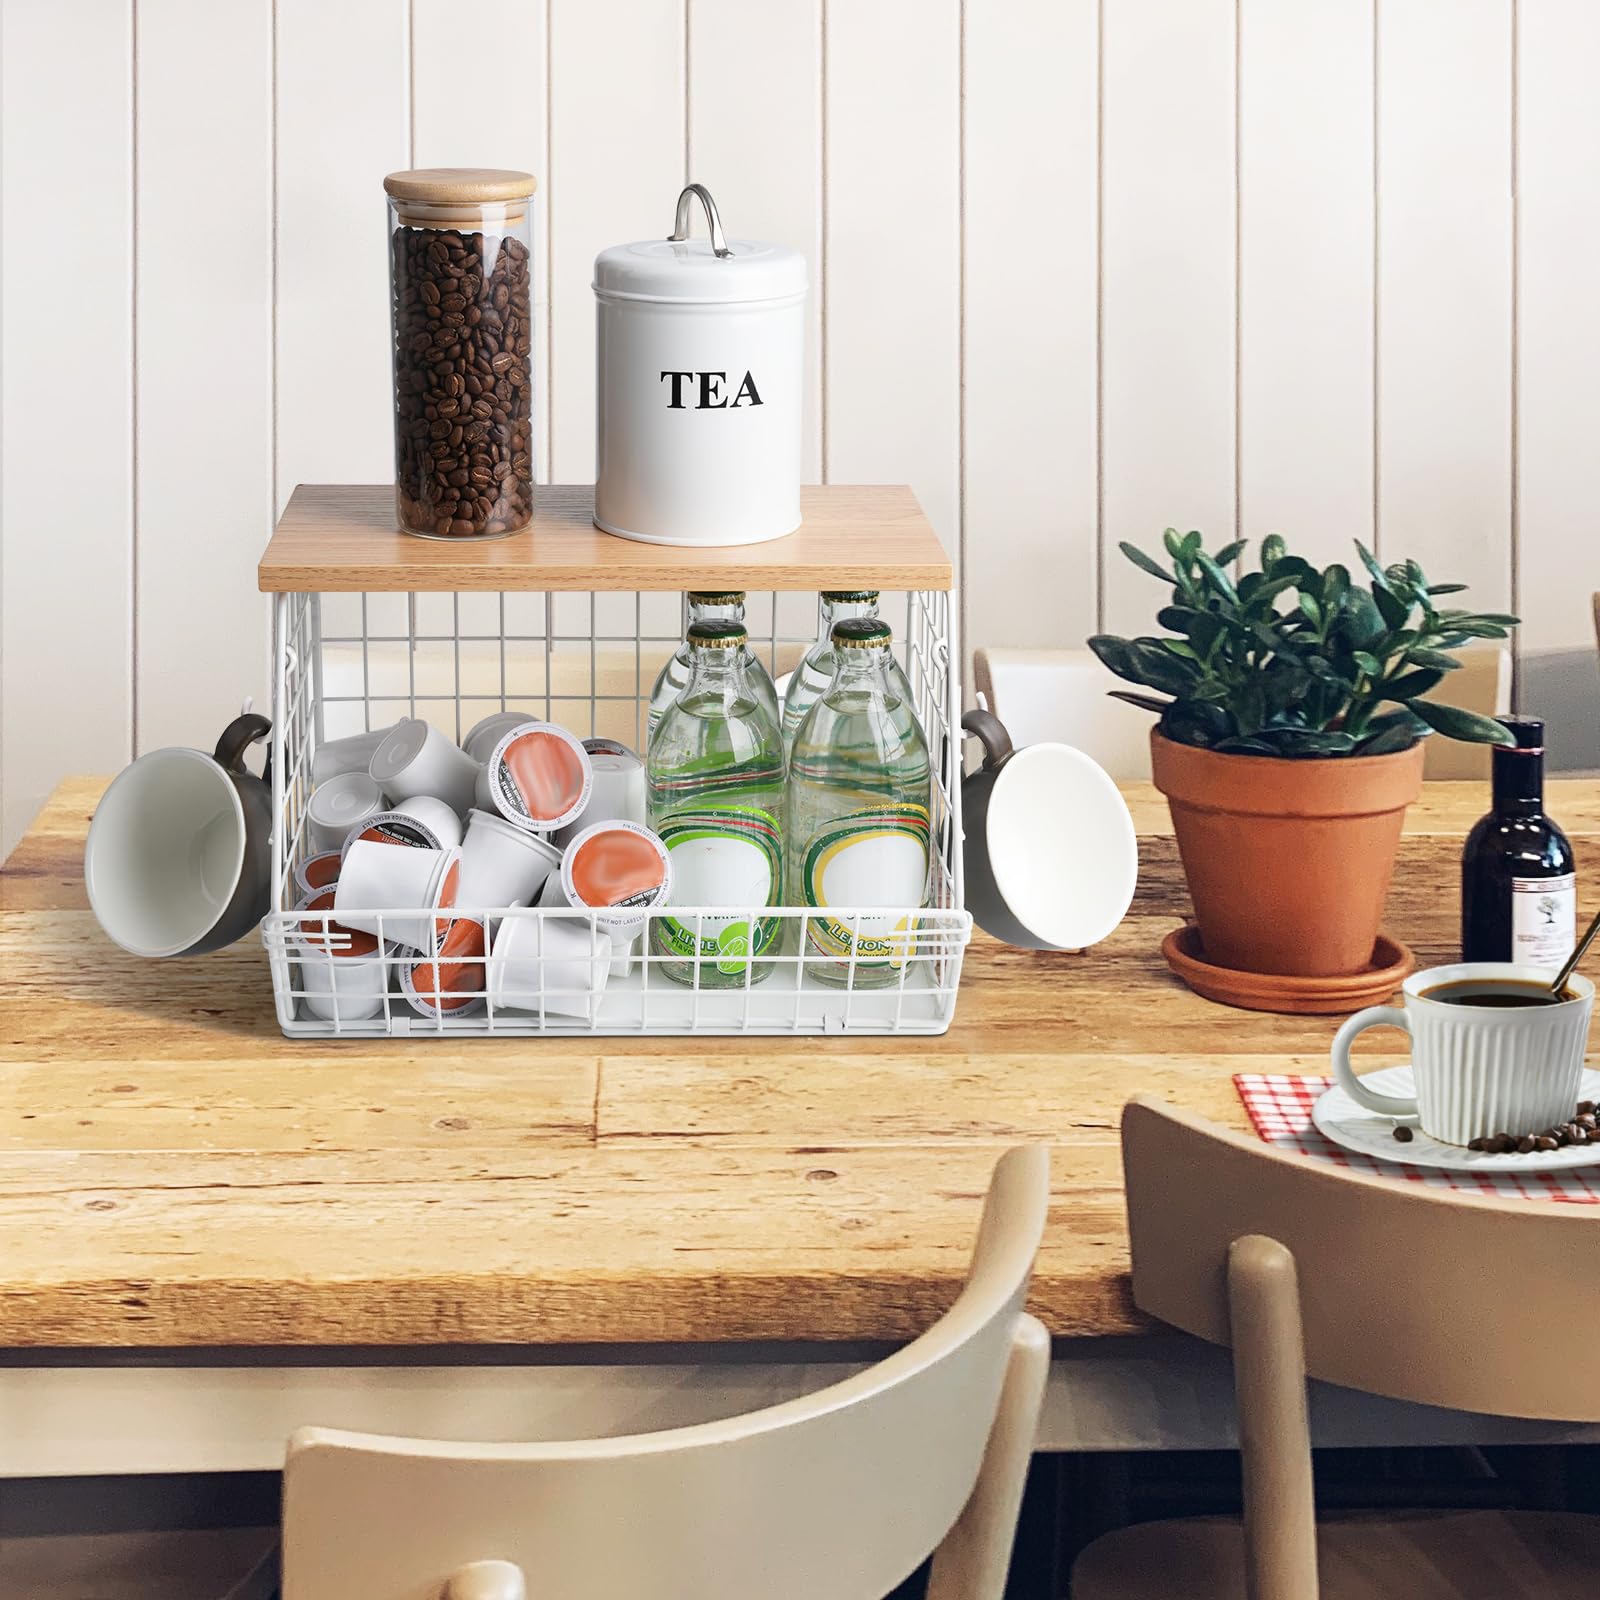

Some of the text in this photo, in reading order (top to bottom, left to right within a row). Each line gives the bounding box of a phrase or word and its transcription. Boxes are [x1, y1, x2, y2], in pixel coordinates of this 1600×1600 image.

[660, 370, 764, 408] TEA
[624, 915, 646, 925] LABELE
[677, 928, 717, 951] LIME
[830, 924, 892, 952] LEMON
